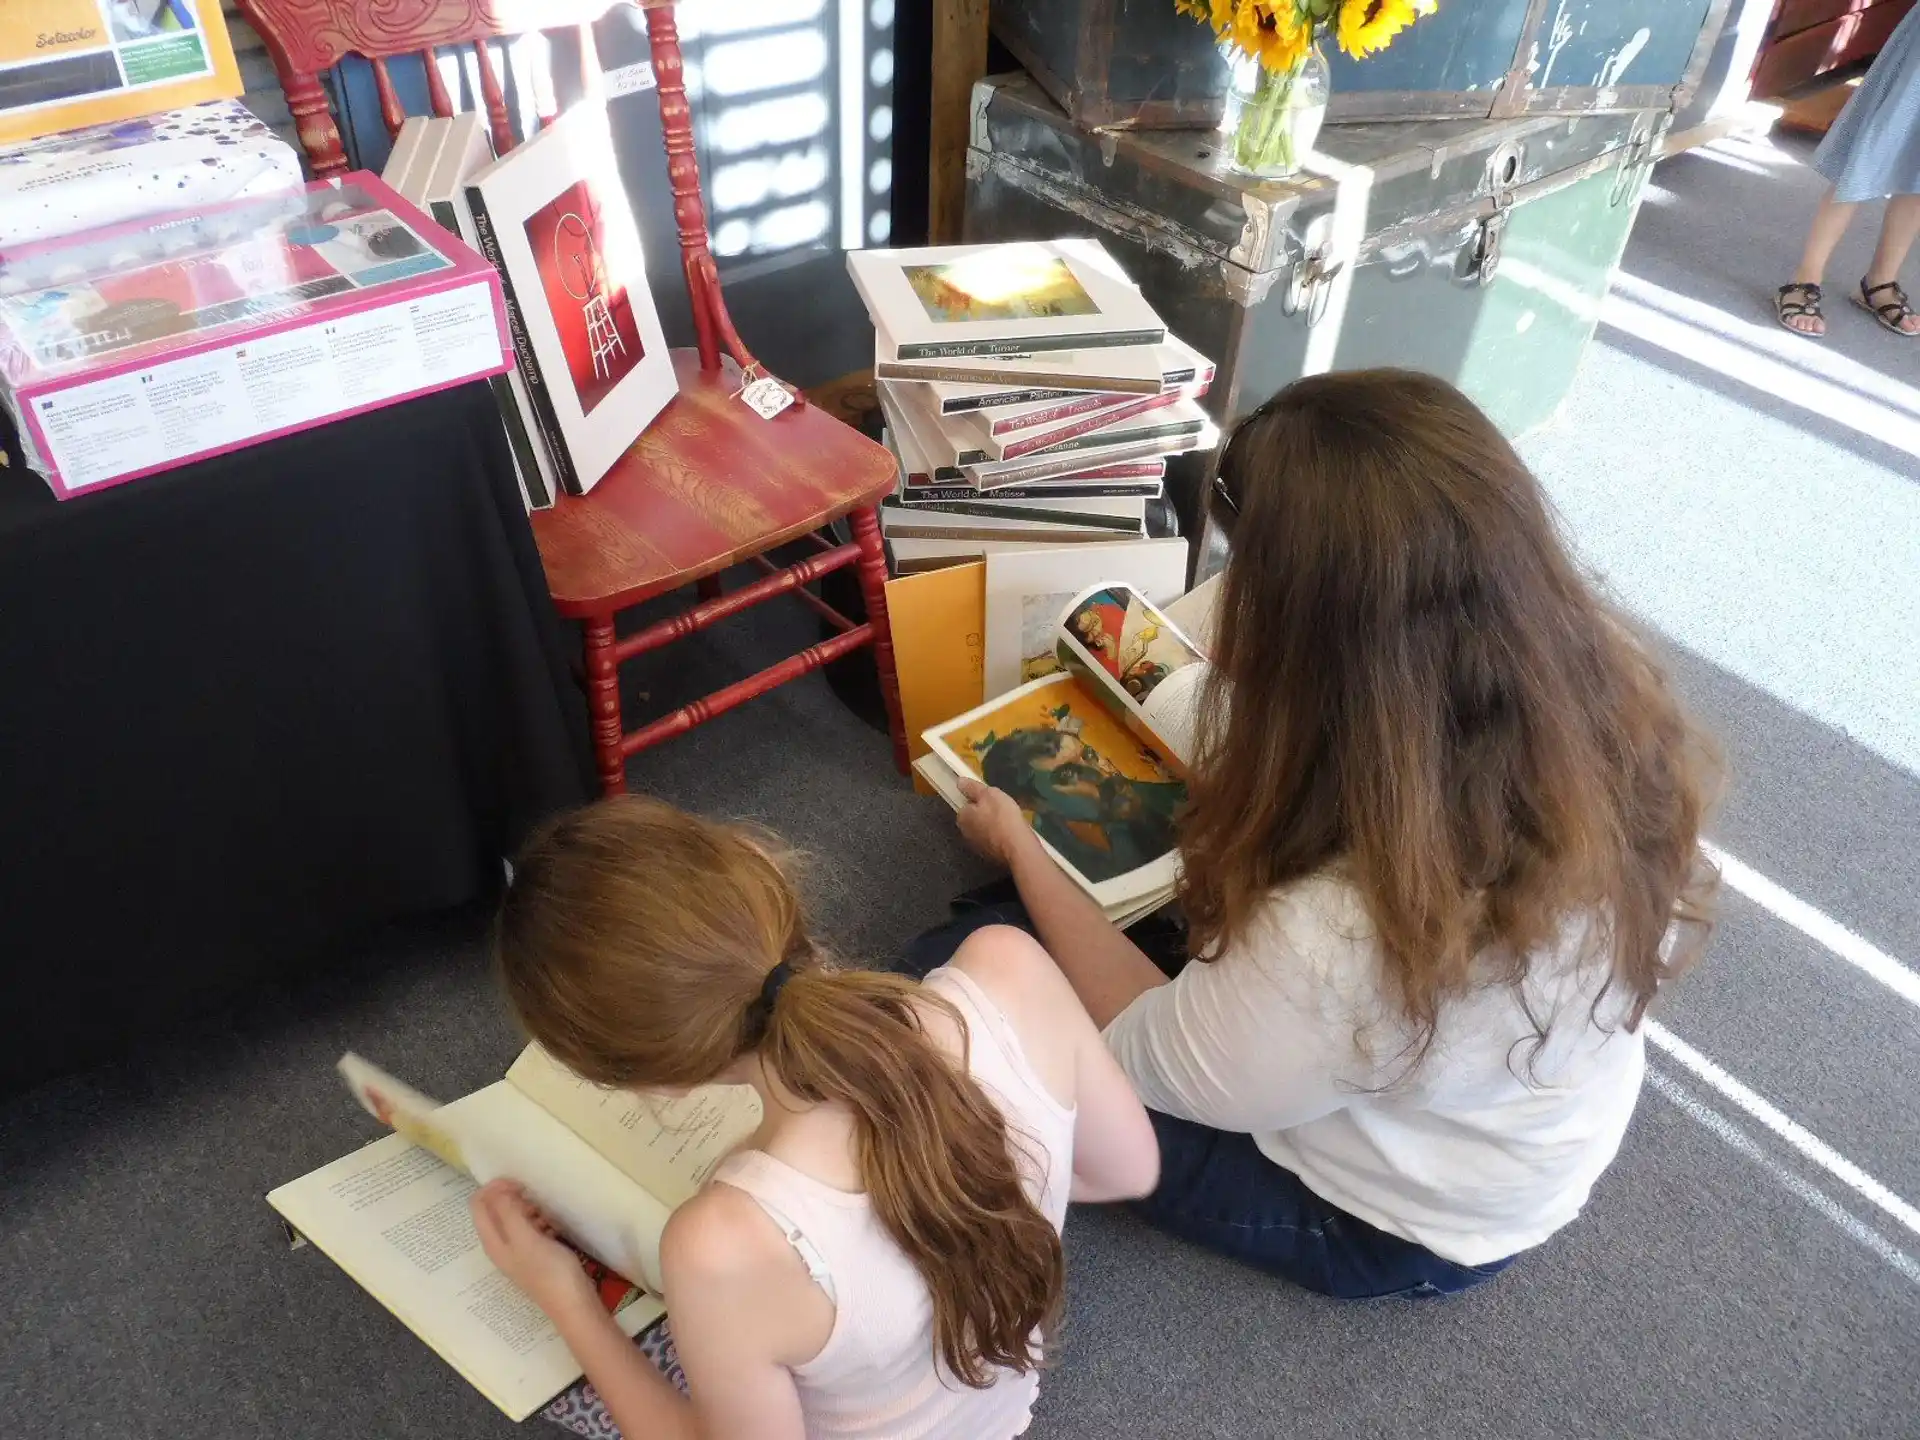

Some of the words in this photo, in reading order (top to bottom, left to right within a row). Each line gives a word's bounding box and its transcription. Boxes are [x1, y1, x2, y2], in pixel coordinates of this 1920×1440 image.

[36, 27, 96, 49] Setacolor
[475, 212, 489, 236] The
[504, 299, 521, 338] Marcel
[516, 337, 540, 385] Duchamp
[918, 348, 937, 357] The
[939, 346, 966, 356] World
[967, 346, 977, 355] of
[988, 344, 1021, 353] Turner
[978, 395, 1020, 407] American
[1029, 389, 1064, 400] Painting
[1009, 418, 1025, 430] The
[1025, 411, 1050, 427] World
[920, 490, 940, 500] The
[940, 489, 969, 499] World
[971, 489, 981, 498] of
[988, 489, 1026, 499] Matisse
